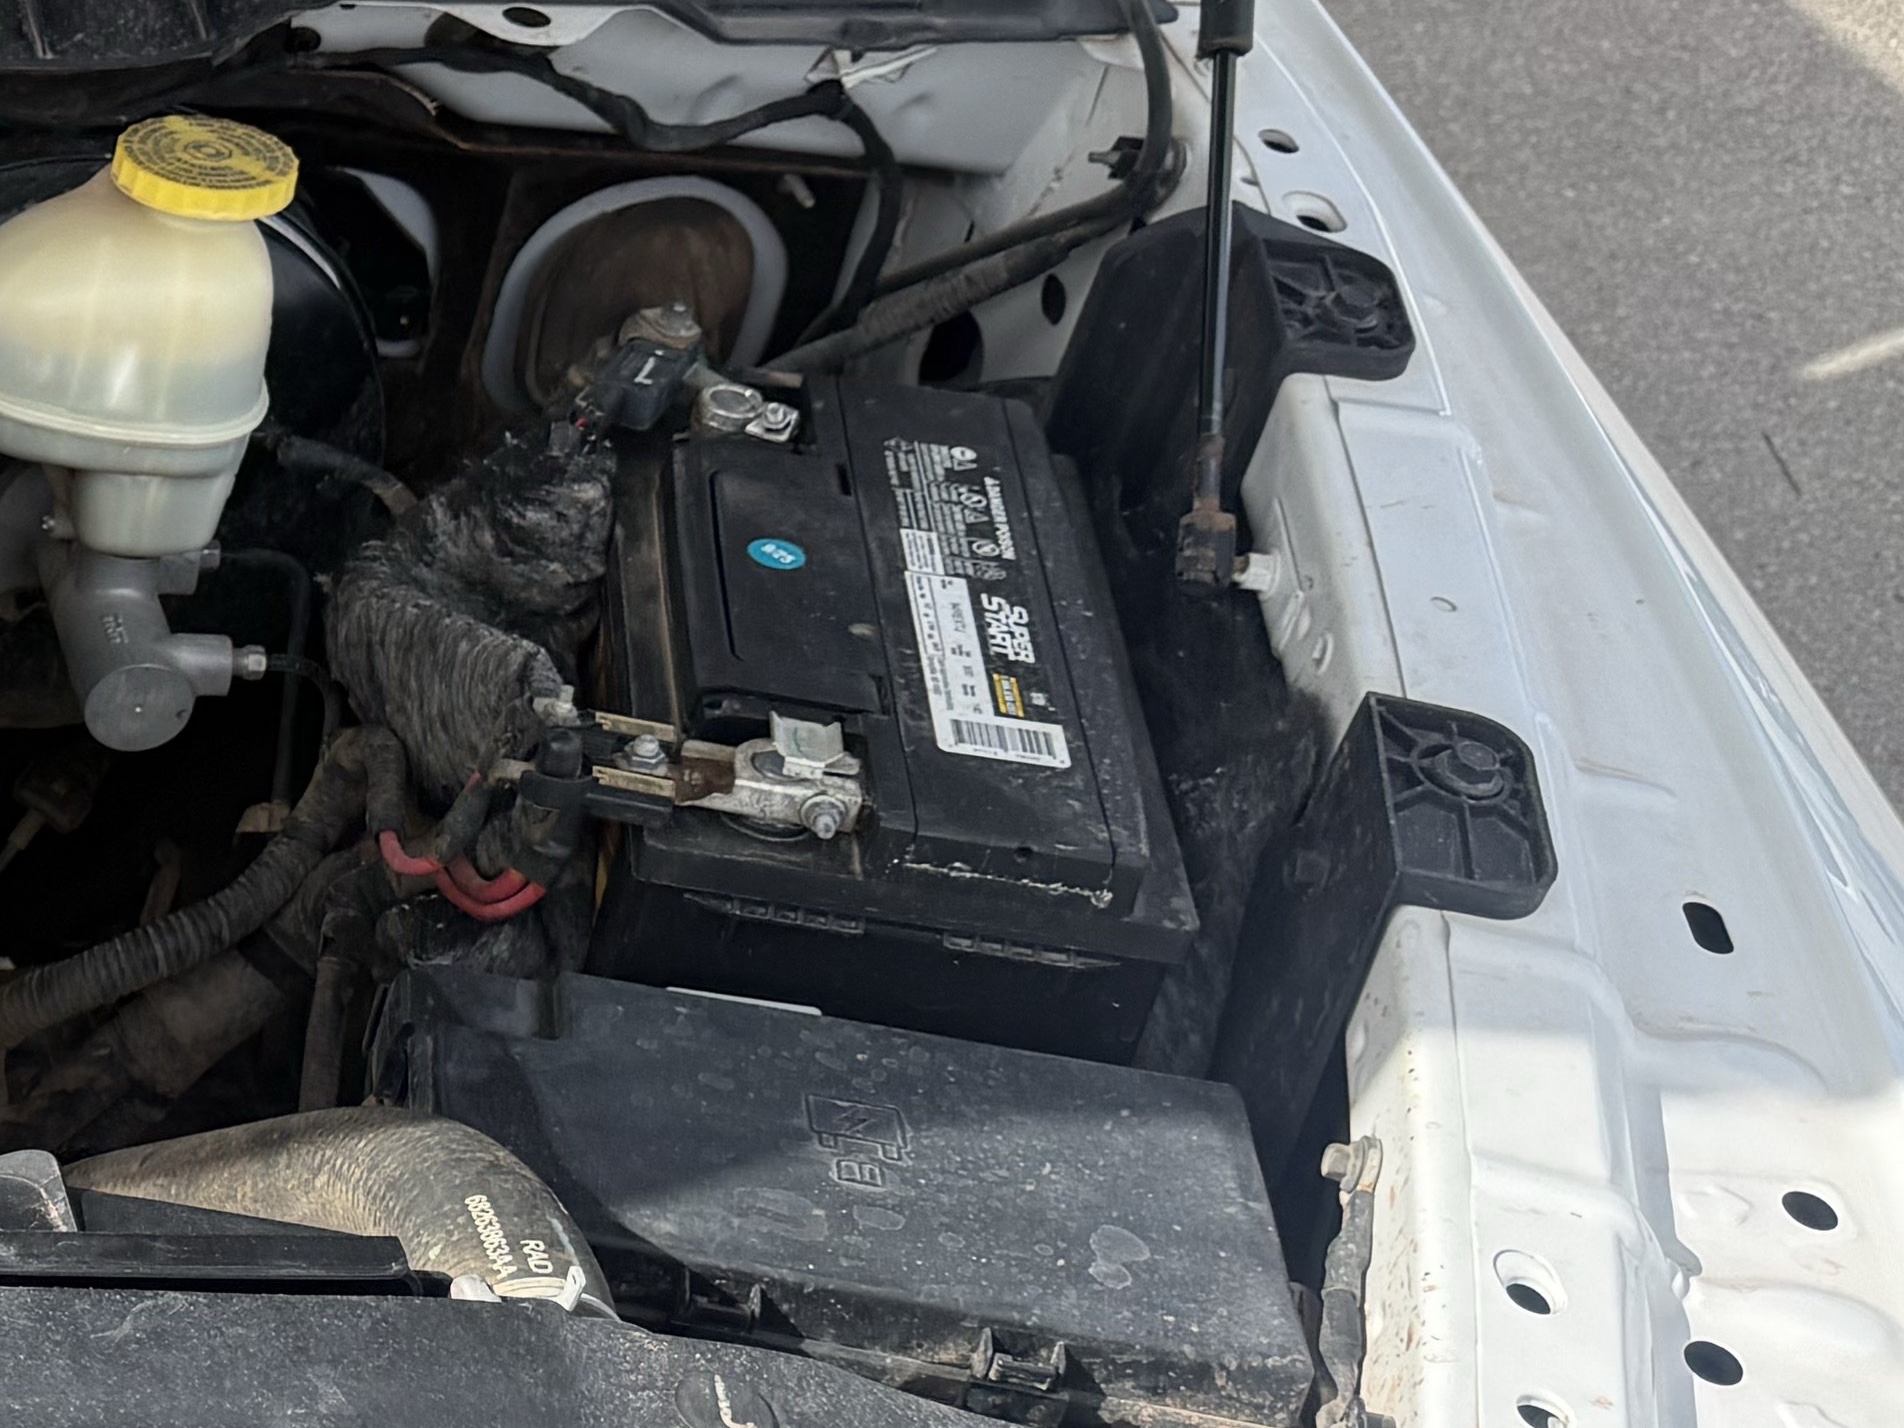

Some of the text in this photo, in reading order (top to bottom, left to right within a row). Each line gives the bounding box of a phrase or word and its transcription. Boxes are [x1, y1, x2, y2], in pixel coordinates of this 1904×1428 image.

[980, 593, 1016, 661] START
[1009, 605, 1035, 663] SUPER
[519, 1239, 554, 1274] RAD
